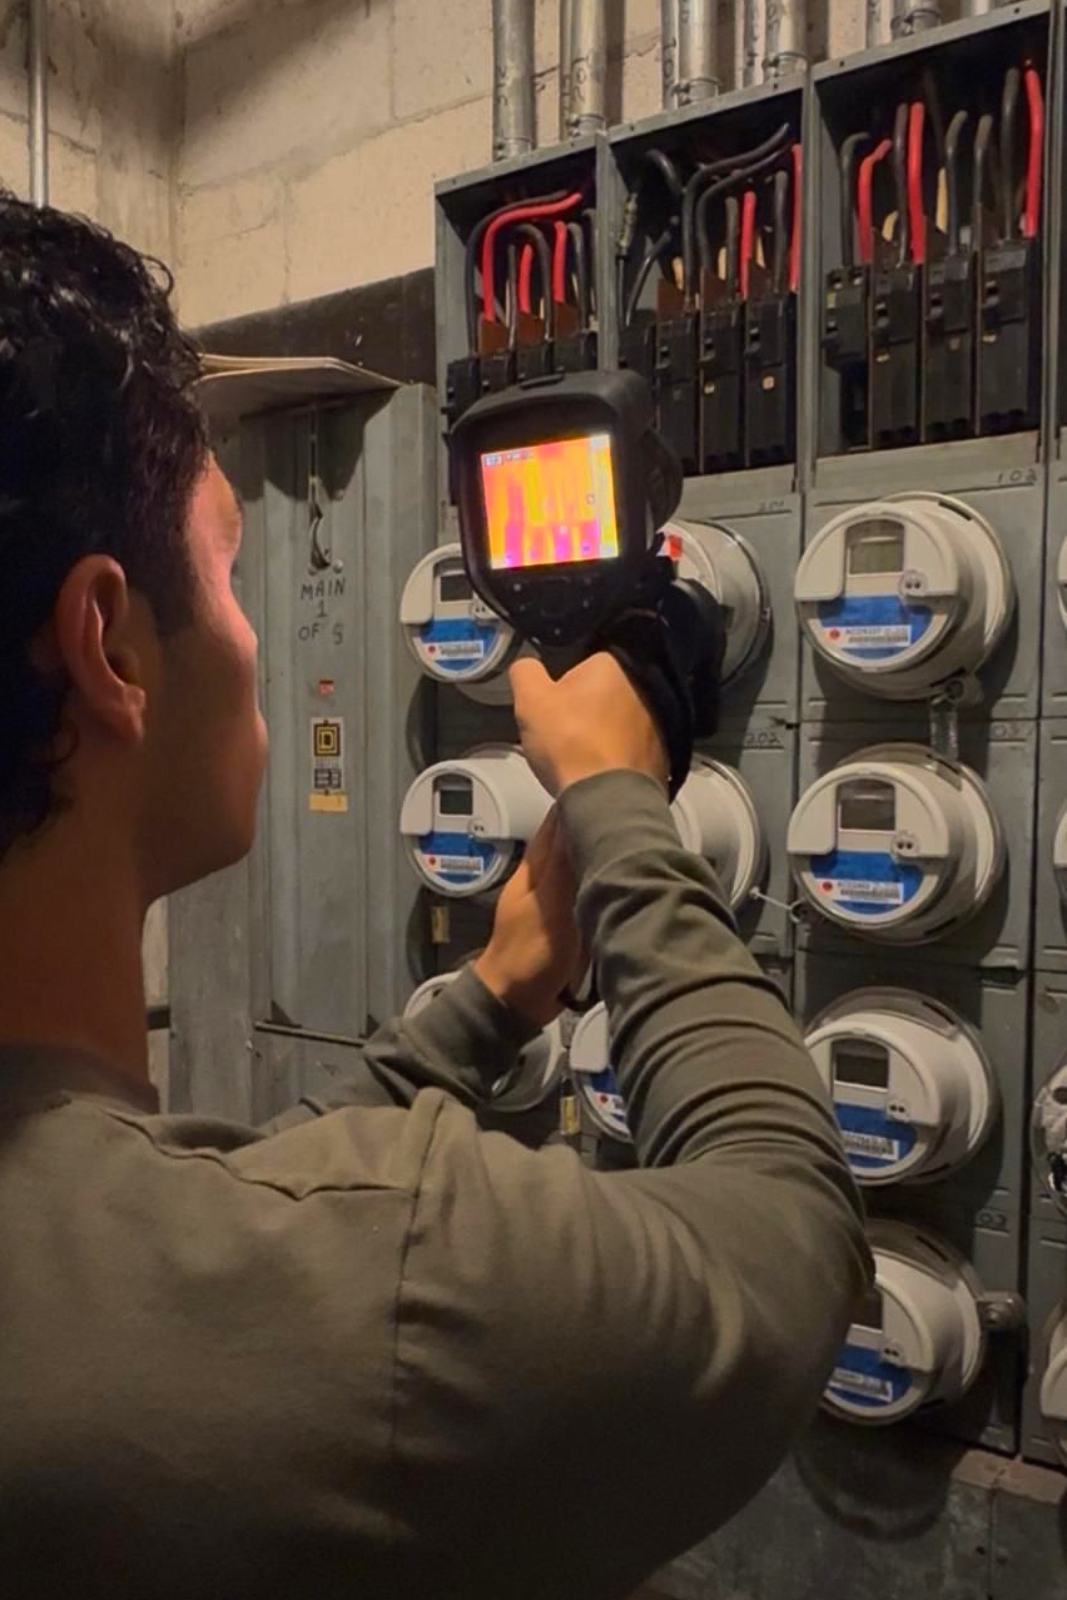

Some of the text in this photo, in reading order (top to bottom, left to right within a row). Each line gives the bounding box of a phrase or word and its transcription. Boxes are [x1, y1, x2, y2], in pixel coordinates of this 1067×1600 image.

[301, 576, 346, 600] MAIN
[316, 600, 328, 618] 1
[297, 622, 344, 646] OF 5
